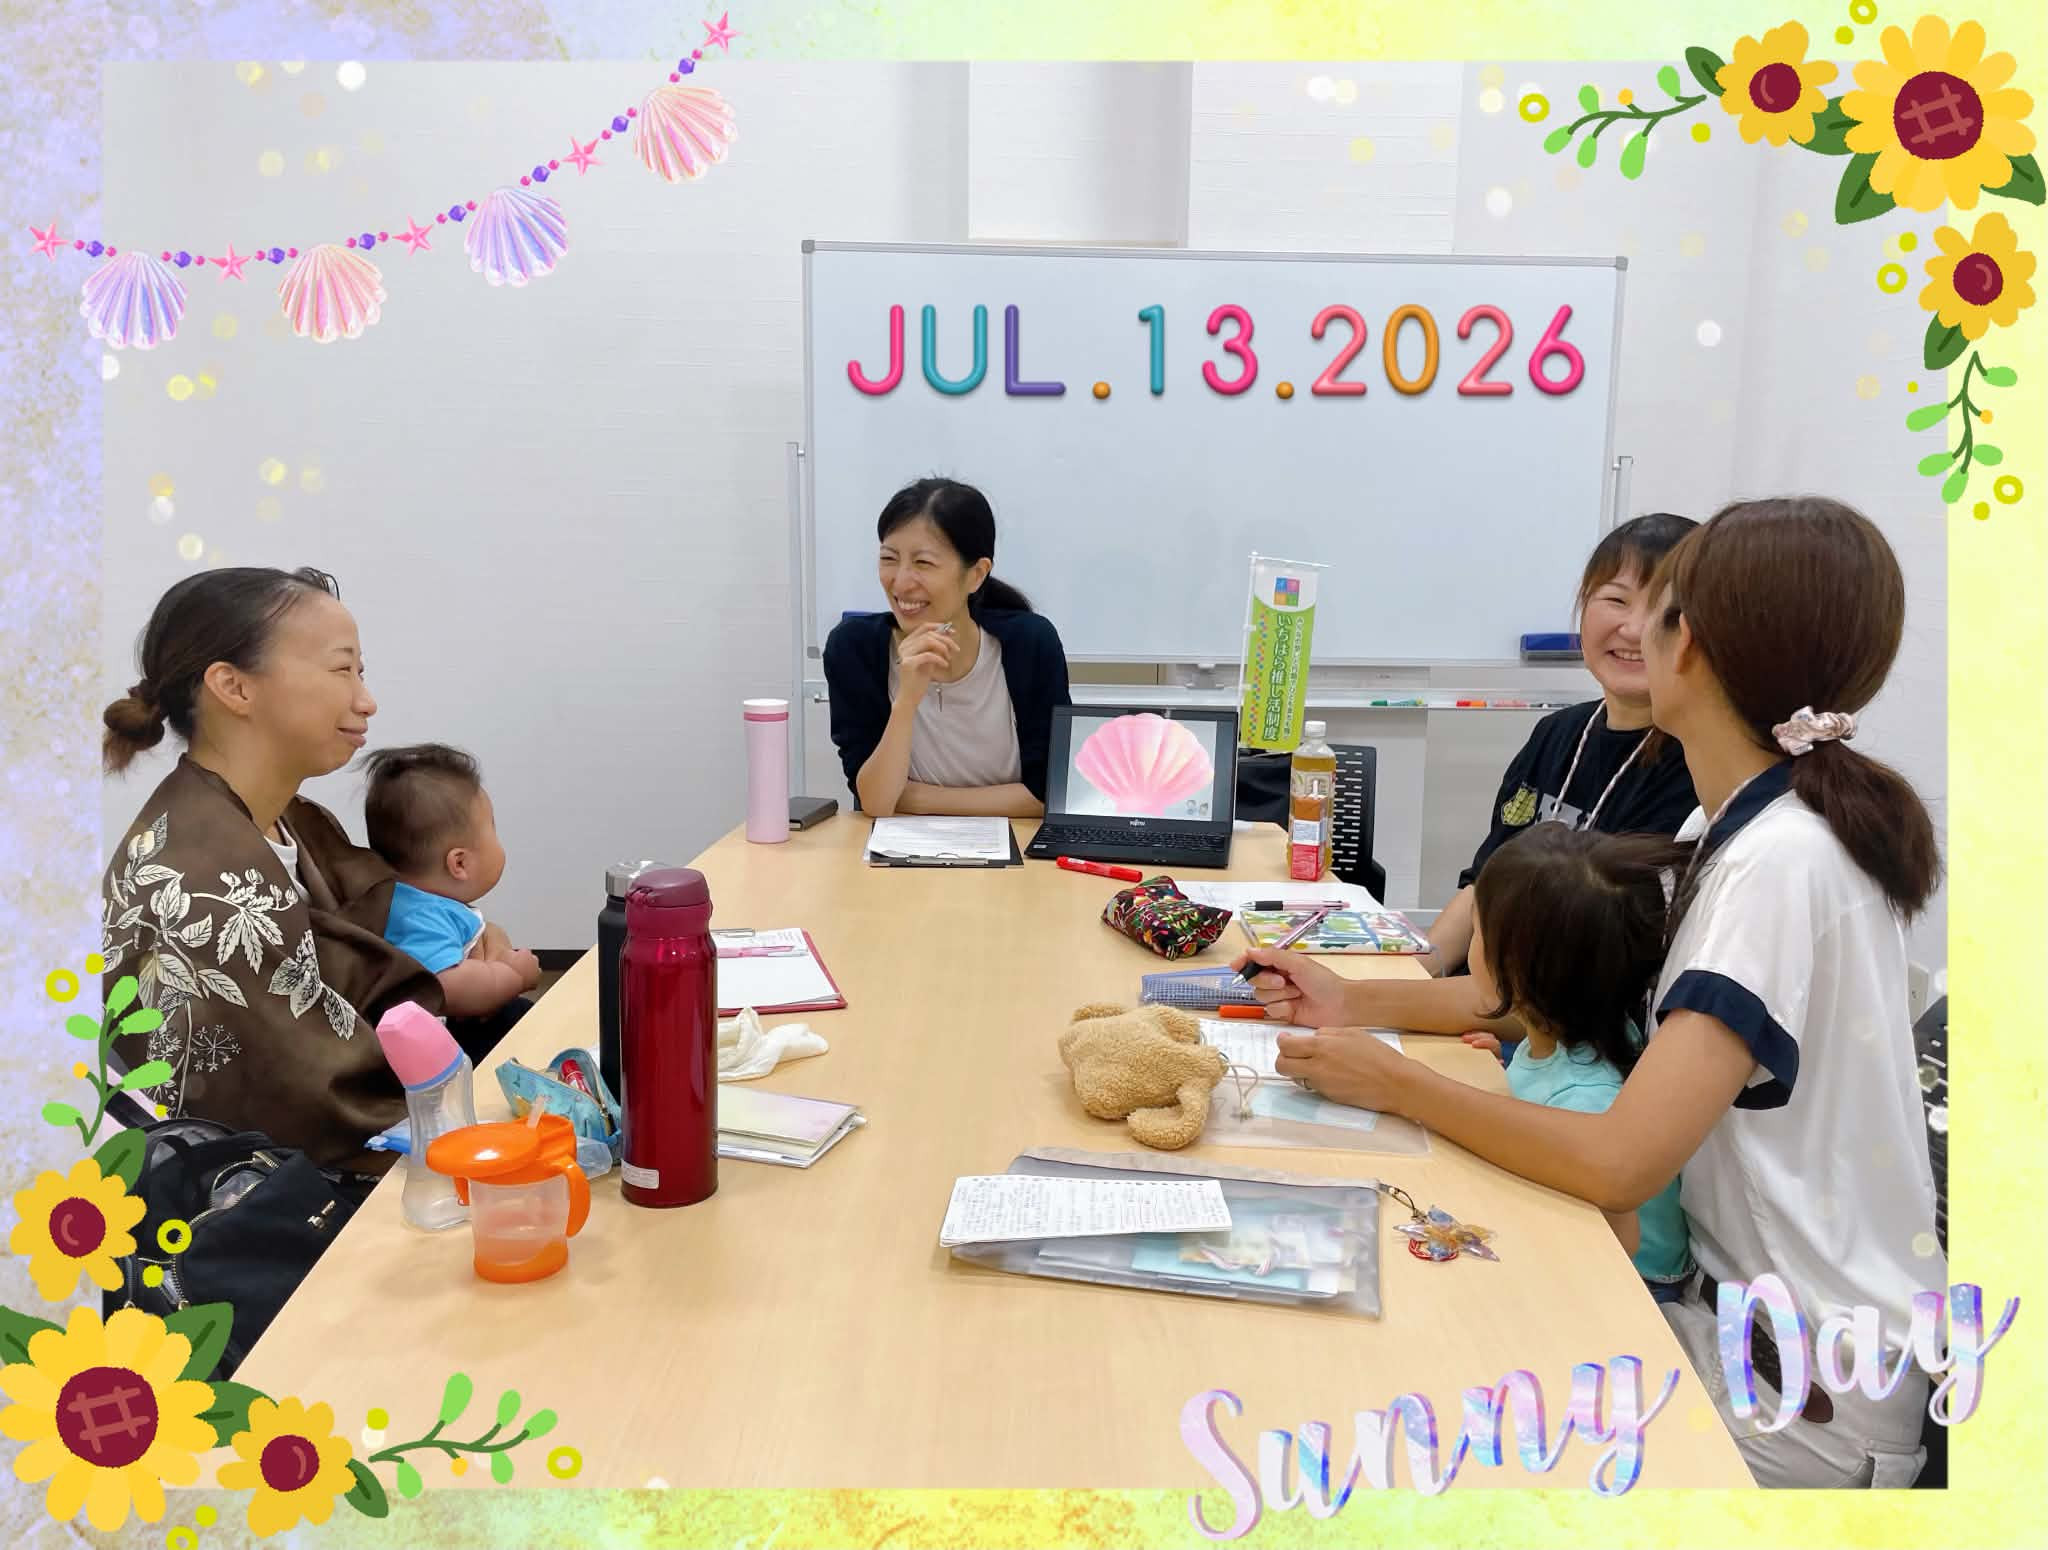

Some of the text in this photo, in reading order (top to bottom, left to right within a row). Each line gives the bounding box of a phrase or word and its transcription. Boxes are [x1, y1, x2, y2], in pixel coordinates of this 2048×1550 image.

[1262, 613, 1292, 741] いちはら推し活制度
